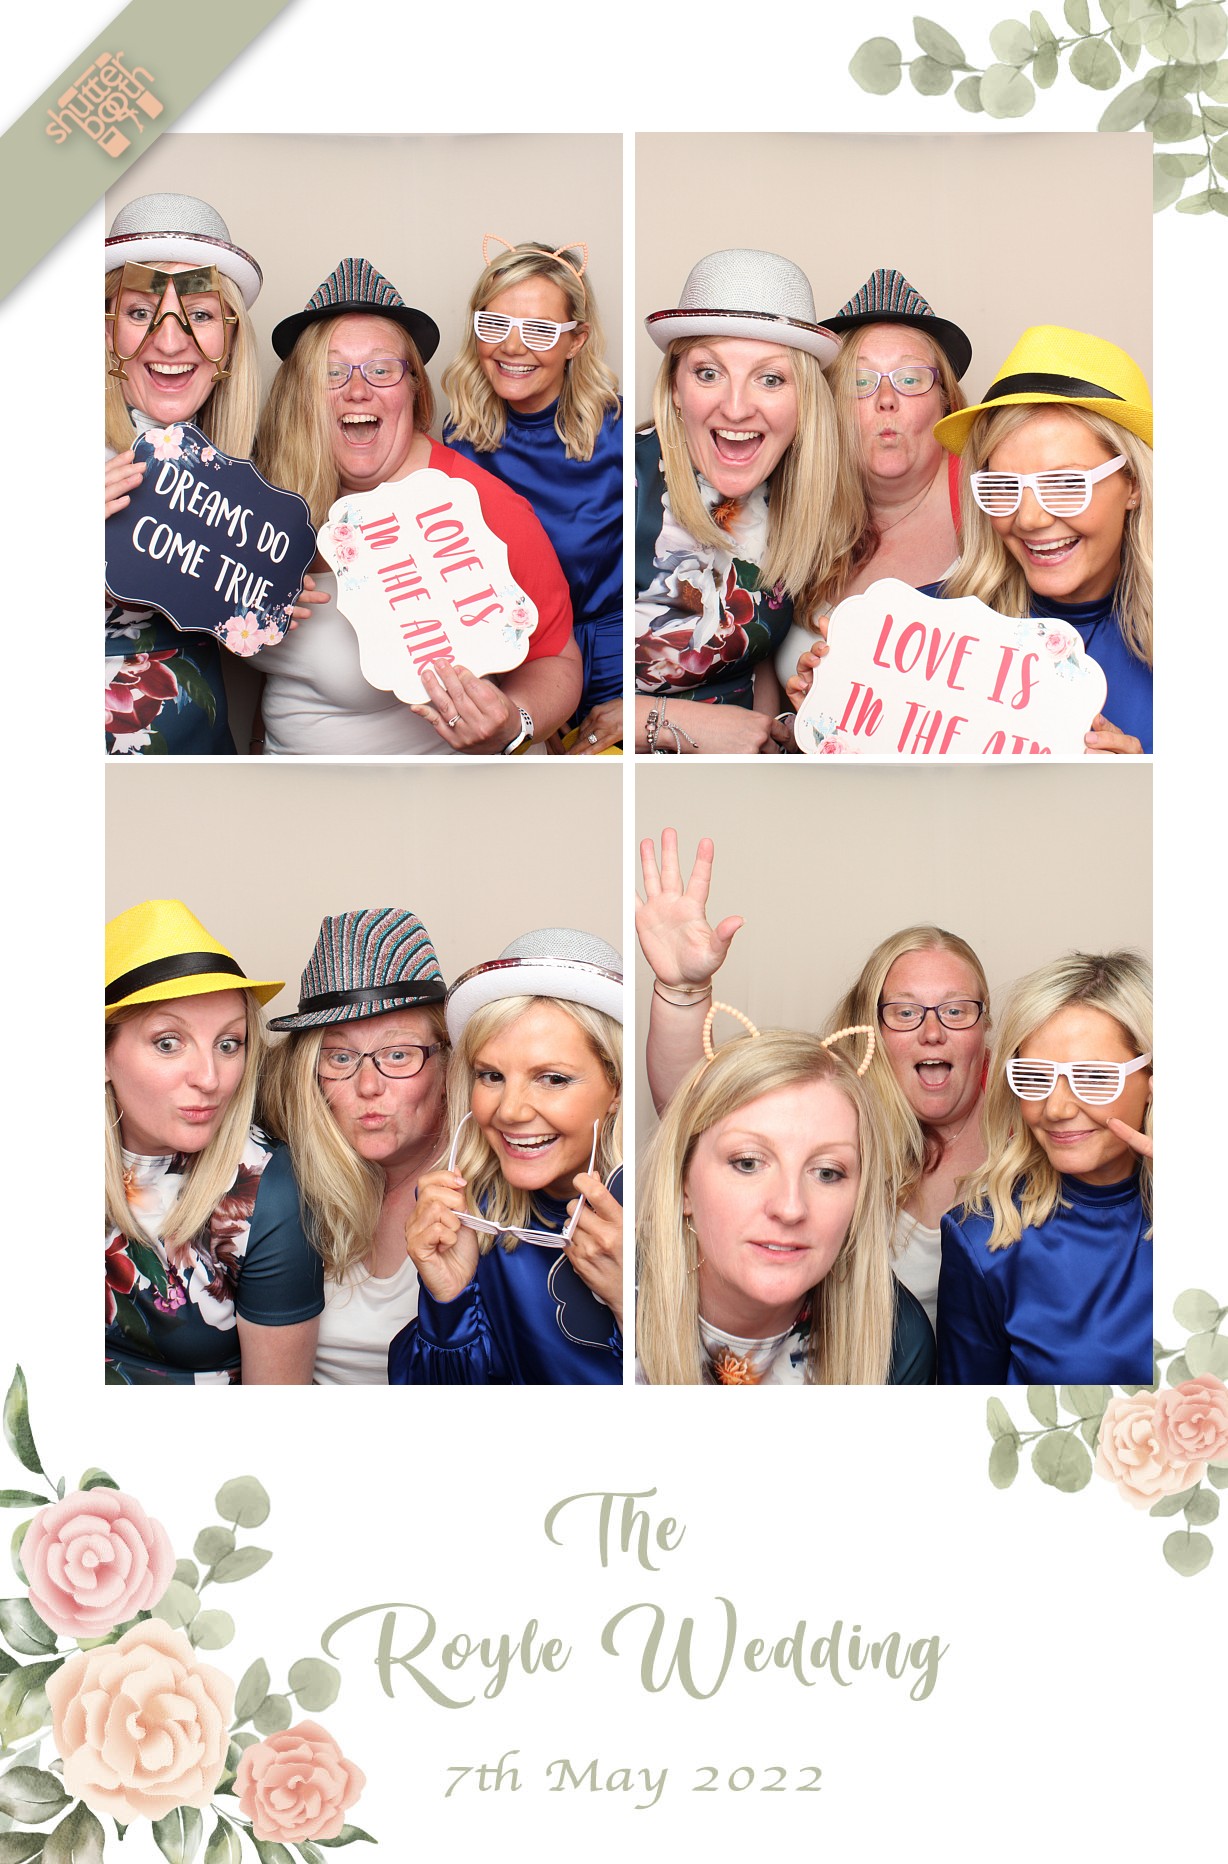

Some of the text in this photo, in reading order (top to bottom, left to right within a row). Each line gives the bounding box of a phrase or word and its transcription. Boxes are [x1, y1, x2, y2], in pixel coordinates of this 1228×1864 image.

[154, 461, 290, 564] DREAMS DO
[132, 515, 274, 612] COME TRUE
[377, 553, 431, 611] THE
[415, 501, 504, 628] LOVE IS
[872, 613, 1041, 710] LOVE IS
[897, 701, 969, 754] THE
